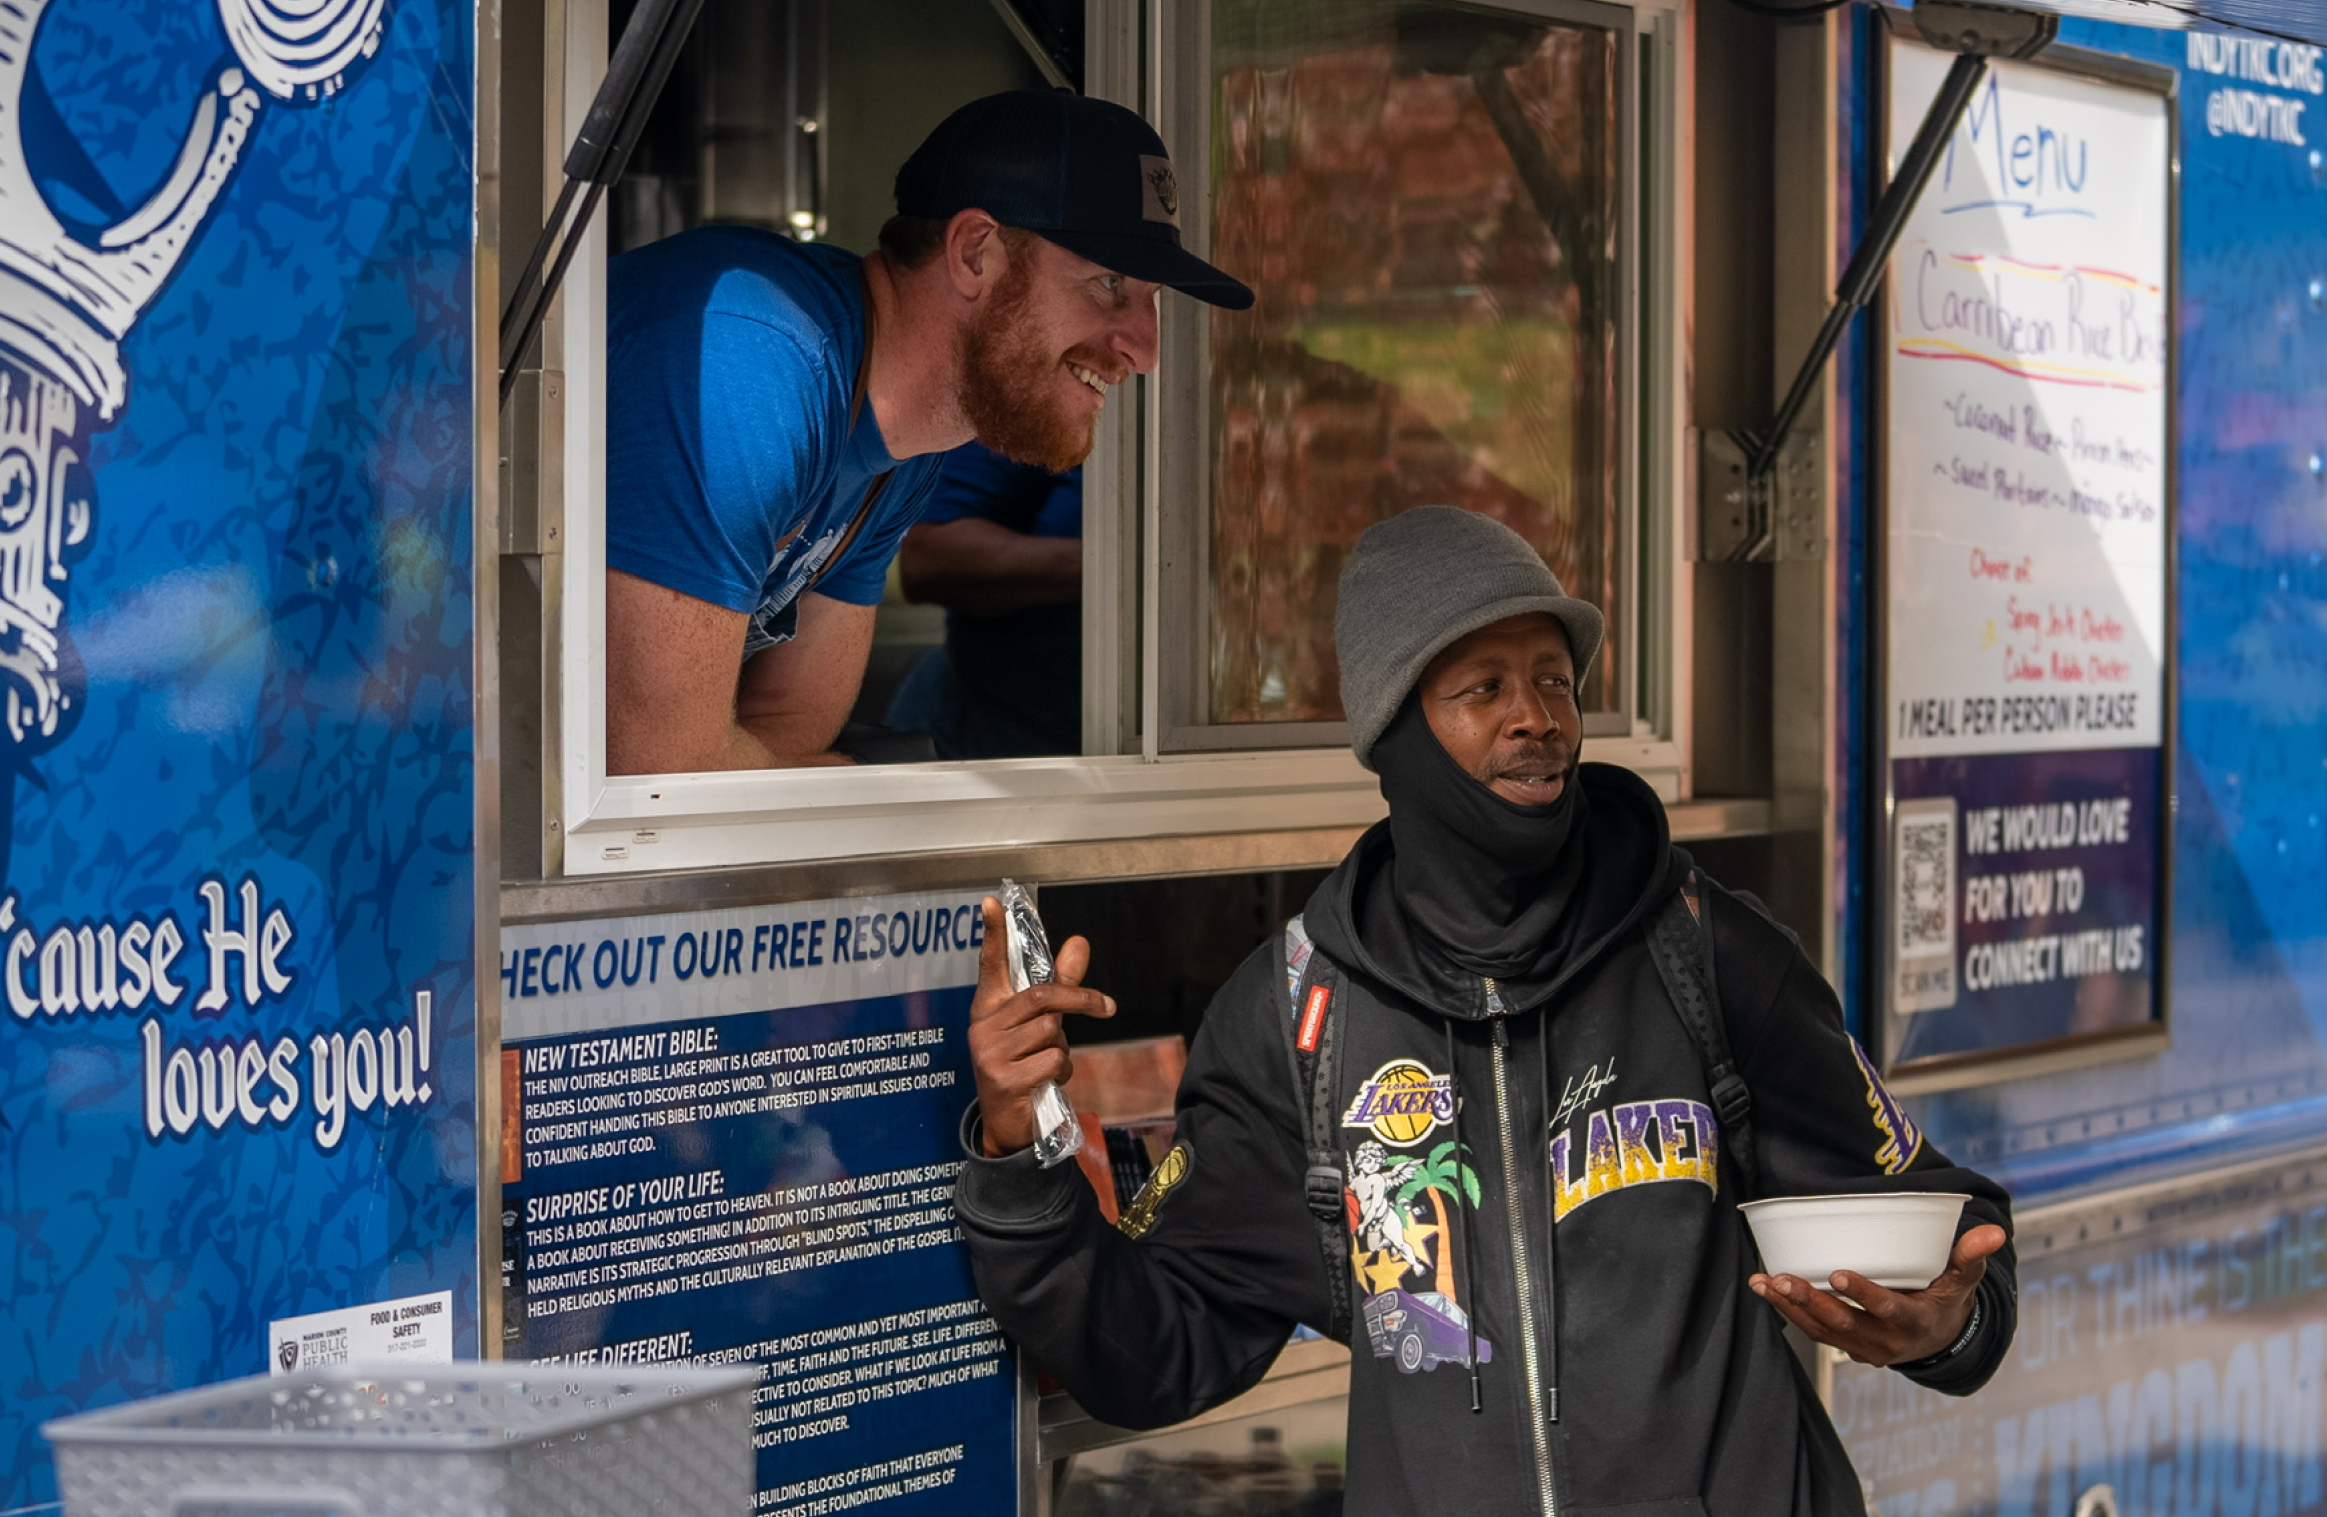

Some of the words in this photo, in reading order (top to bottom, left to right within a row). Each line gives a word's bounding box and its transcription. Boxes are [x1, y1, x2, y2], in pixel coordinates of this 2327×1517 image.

[1944, 69, 2087, 197] Menu
[1909, 698, 1956, 738] MEAL
[1962, 697, 1997, 735] PER
[2000, 694, 2070, 734] PERSON
[2076, 692, 2138, 731] PLEASE
[1965, 807, 2001, 855] WE
[2003, 801, 2077, 852] WOULD
[2079, 797, 2132, 845] LOVE
[1964, 874, 2007, 924] FOR
[2009, 869, 2053, 919] YOU
[2056, 866, 2084, 914] TO
[196, 879, 292, 1011] He
[593, 938, 666, 989] OUT
[673, 930, 744, 980] OUR
[751, 920, 823, 972] FREE
[832, 905, 984, 962] RESOURCE
[1964, 937, 2059, 991] CONNECT
[2061, 930, 2114, 978] WITH
[2115, 924, 2144, 972] US
[142, 1019, 299, 1138] loves
[310, 990, 432, 1149] you!
[525, 1044, 565, 1073] NEW
[570, 1032, 663, 1068] TESTAMENT
[669, 1026, 717, 1055] BIBLE:
[525, 1079, 547, 1096] THE
[549, 1076, 568, 1093] NIV
[569, 1068, 629, 1091] OUTREACH
[630, 1064, 661, 1083] BIBLE,
[663, 1060, 697, 1079] LARGE
[698, 1056, 728, 1074] PRINT
[730, 1054, 740, 1071] IS
[742, 1054, 749, 1069] A
[750, 1049, 781, 1067] GREAT
[784, 1045, 809, 1063] TOOL
[812, 1043, 826, 1059] TO
[827, 1039, 849, 1057] GIVE
[851, 1037, 865, 1054] TO
[866, 1030, 916, 1052] FIRST-TIME
[918, 1027, 943, 1045] BIBLE
[525, 1098, 575, 1120] READERS
[577, 1092, 625, 1113] LOOKING
[627, 1090, 642, 1106] TO
[644, 1083, 696, 1104] DISCOVER
[698, 1079, 730, 1097] GOD'S
[731, 1074, 766, 1092] WORD.
[771, 1070, 792, 1088] YOU
[793, 1067, 814, 1084] CAN
[815, 1064, 837, 1082] FEEL
[839, 1055, 907, 1078] COMFORTABLE
[909, 1052, 929, 1068] AND
[525, 1120, 587, 1144] CONFIDENT
[589, 1113, 639, 1135] HANDING
[642, 1110, 665, 1128] THIS
[667, 1106, 696, 1124] BIBLE
[698, 1103, 712, 1120] TO
[714, 1097, 756, 1117] ANYONE
[757, 1089, 817, 1111] INTERESTED
[818, 1087, 829, 1103] IN
[830, 1081, 876, 1101] SPIRITUAL
[879, 1076, 912, 1094] ISSUES
[913, 1074, 927, 1089] OR
[929, 1070, 954, 1088] OPEN
[1348, 1084, 1453, 1123] LAKERS
[1408, 1080, 1451, 1090] ANGELE
[526, 1150, 542, 1168] TO
[544, 1144, 588, 1165] TALKING
[590, 1139, 626, 1159] ABOUT
[628, 1135, 655, 1153] GOD.
[526, 1187, 608, 1223] SURPRISE
[612, 1183, 634, 1210] OF
[640, 1175, 684, 1205] YOUR
[688, 1169, 724, 1198] LIFE:
[527, 1227, 552, 1246] THIS
[554, 1225, 564, 1243] IS
[566, 1224, 574, 1240] A
[575, 1218, 607, 1239] BOOK
[609, 1212, 645, 1233] ABOUT
[647, 1207, 675, 1226] HOW
[677, 1205, 691, 1222] TO
[692, 1202, 712, 1219] GET
[715, 1199, 729, 1215] TO
[730, 1192, 773, 1213] HEAVEN.
[774, 1190, 784, 1205] IT
[785, 1188, 796, 1204] IS
[796, 1185, 817, 1202] NOT
[819, 1183, 826, 1198] A
[827, 1178, 856, 1197] BOOK
[857, 1172, 889, 1192] ABOUT
[891, 1167, 923, 1187] DOING
[326, 1327, 348, 1338] COUNTY
[370, 1311, 391, 1326] FOOD
[401, 1301, 443, 1319] CONSUMER
[393, 1322, 421, 1339] SAFETY
[707, 1346, 742, 1368] SEVEN
[743, 1343, 757, 1360] OF
[759, 1339, 778, 1357] THE
[780, 1333, 808, 1353] MOST
[810, 1324, 856, 1346] COMMON
[857, 1319, 878, 1337] AND
[880, 1315, 896, 1333] YET
[898, 1309, 924, 1329] MOST
[926, 1299, 978, 1323] IMPORTANT
[302, 1351, 348, 1372] HEALTH
[303, 1336, 348, 1357] PUBLIC
[602, 1332, 692, 1370] DIFFERENT:
[749, 1429, 781, 1450] MUCH
[783, 1425, 797, 1442] TO
[798, 1414, 849, 1439] DISCOVER.
[758, 1481, 806, 1506] BUILDING
[807, 1472, 845, 1495] BLOCKS
[845, 1469, 858, 1486] OF
[860, 1462, 888, 1482] FAITH
[890, 1455, 912, 1475] THAT
[914, 1444, 963, 1470] EVERYONE
[808, 1498, 827, 1517] THE
[828, 1481, 901, 1508] FOUNDATIONAL
[904, 1471, 941, 1493] THEMES
[942, 1467, 954, 1485] OF
